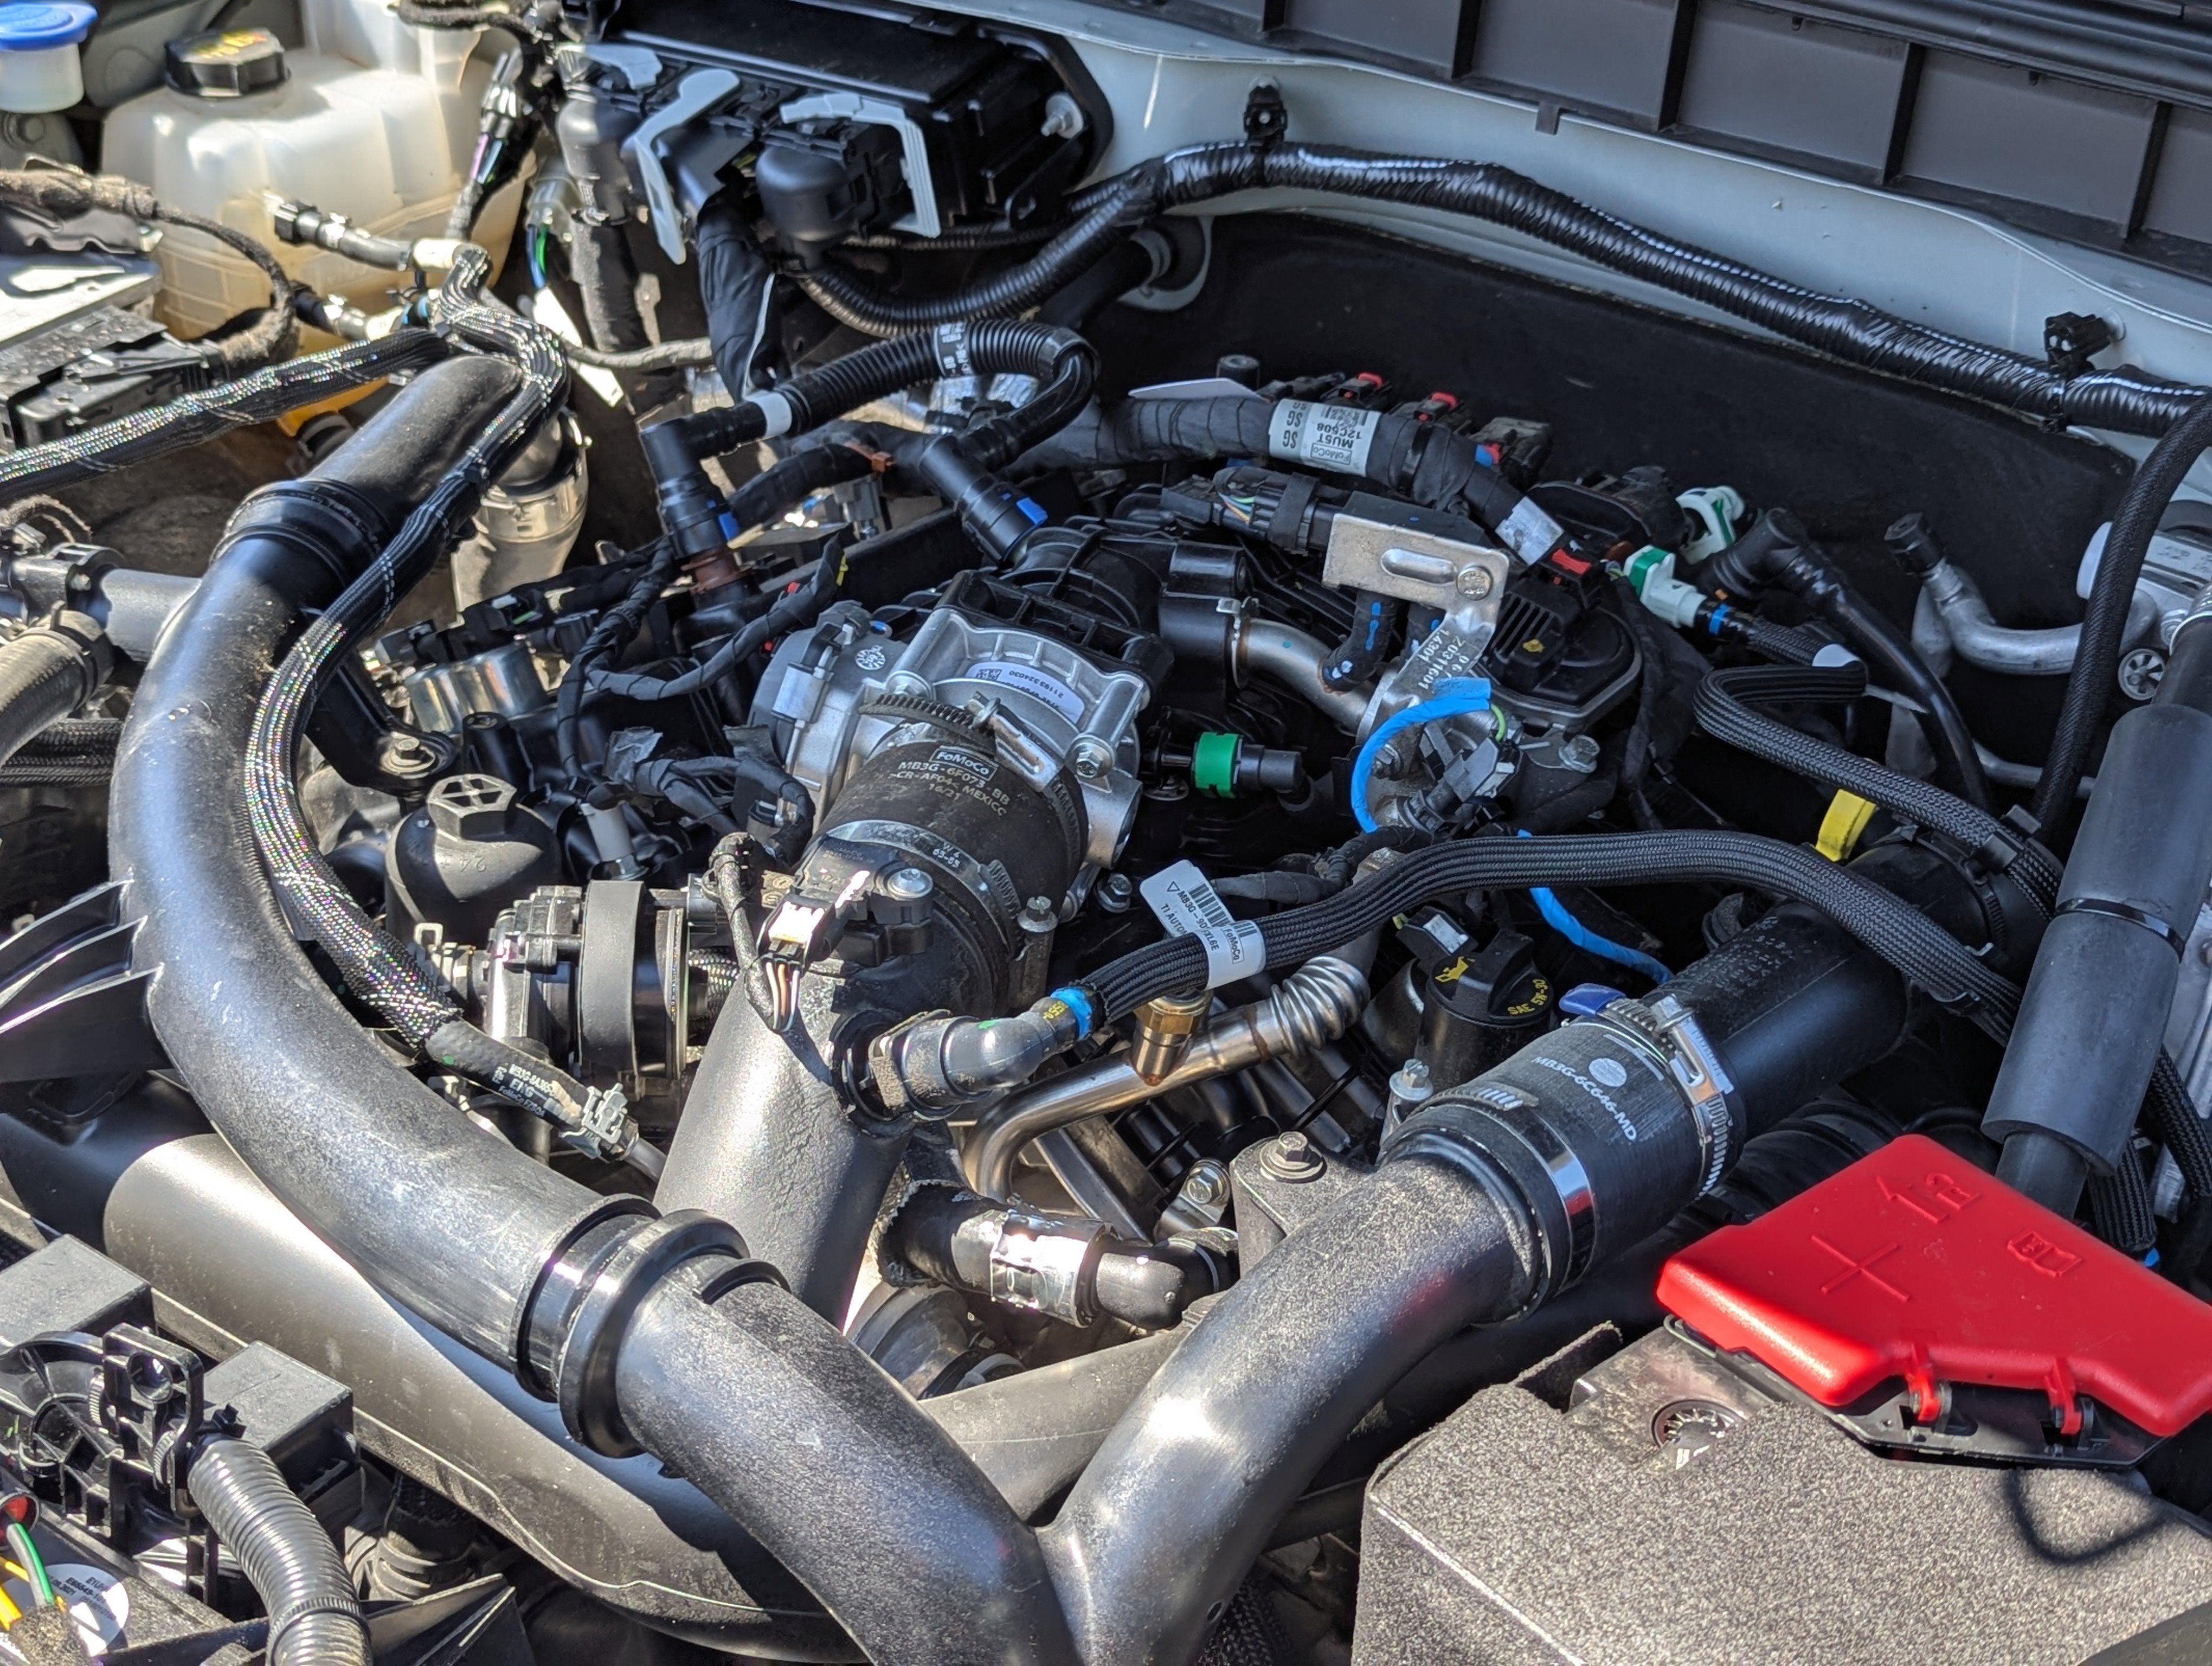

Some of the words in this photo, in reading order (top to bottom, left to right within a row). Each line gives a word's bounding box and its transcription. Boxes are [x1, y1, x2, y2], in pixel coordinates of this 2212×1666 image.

[1285, 409, 1303, 427] SG
[1282, 429, 1298, 449] SG
[1316, 422, 1362, 439] 12C508
[1316, 433, 1353, 448] MU5T
[1312, 446, 1349, 462] FoMoCo
[936, 751, 990, 776] FoMoCo
[928, 782, 961, 799] 16/21
[932, 849, 960, 868] 65-85
[1161, 902, 1170, 913] TI
[1224, 928, 1240, 960] FoMoCo
[1507, 1002, 1534, 1015] SAE
[1531, 1056, 1637, 1140] MB3G-6C646-MD
